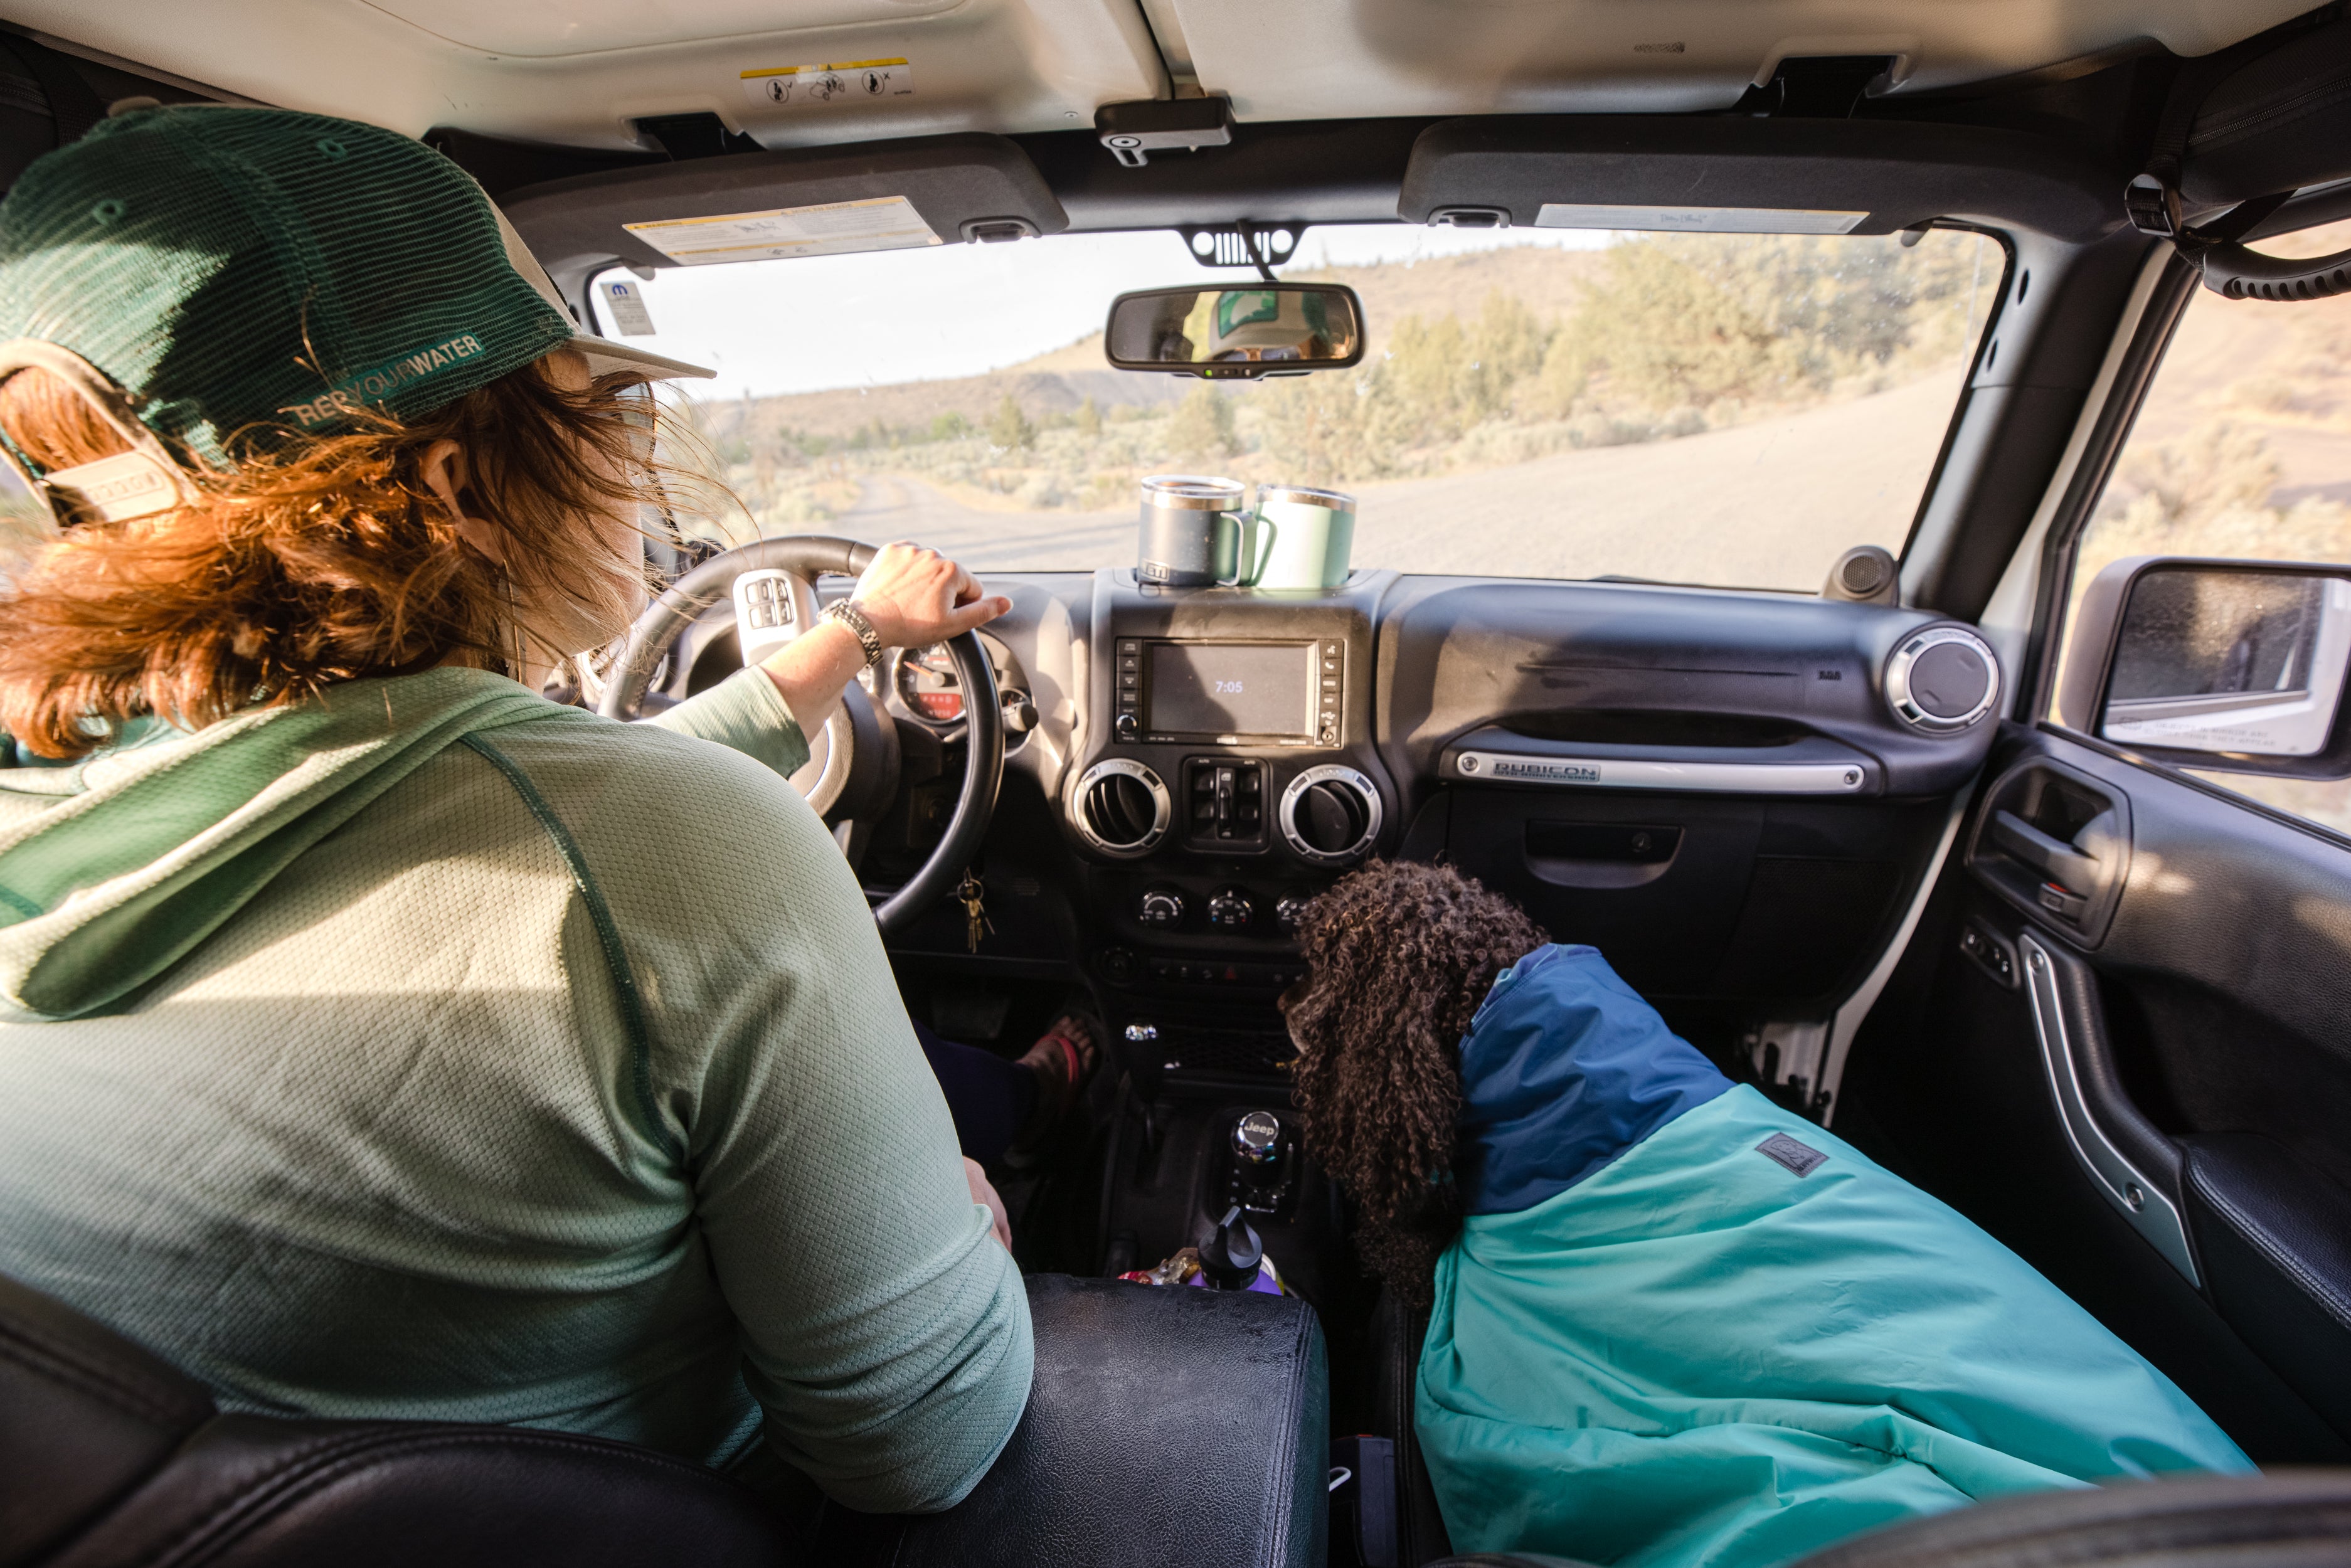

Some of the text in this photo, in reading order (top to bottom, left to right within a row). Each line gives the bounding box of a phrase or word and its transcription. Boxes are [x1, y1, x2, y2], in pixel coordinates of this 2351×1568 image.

[1142, 562, 1167, 578] YETI
[1215, 681, 1243, 693] 7:05
[1495, 763, 1596, 776] RUBICON
[1244, 1121, 1275, 1136] Jeep
